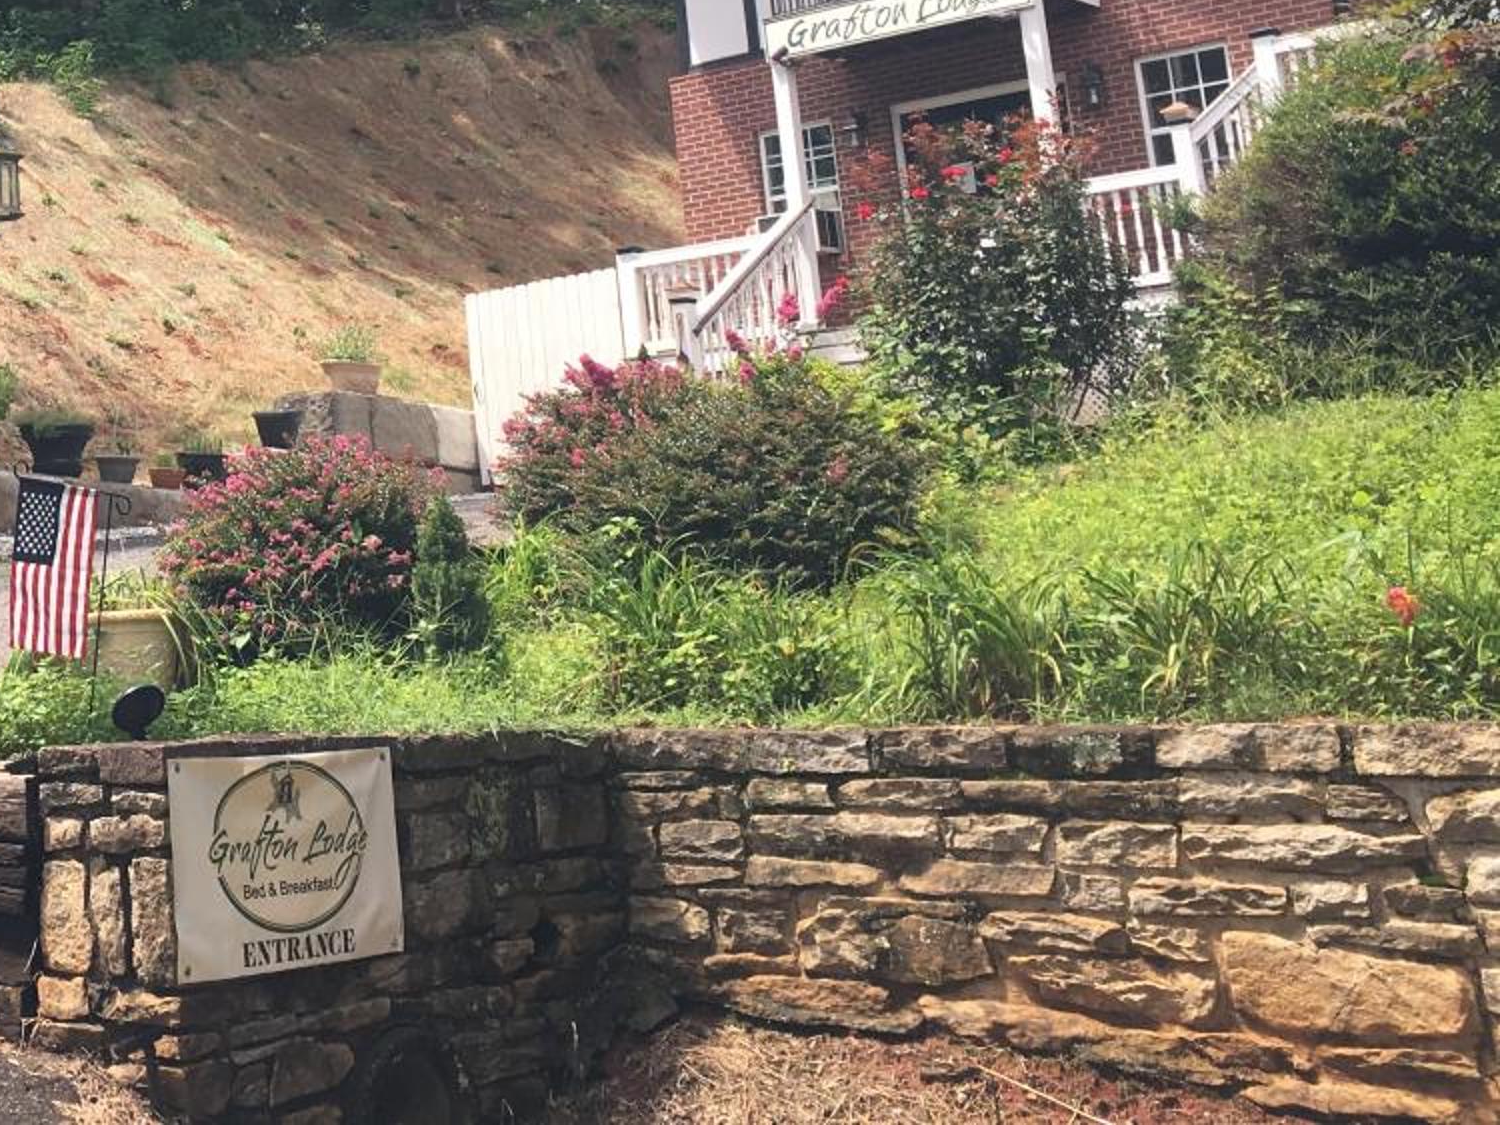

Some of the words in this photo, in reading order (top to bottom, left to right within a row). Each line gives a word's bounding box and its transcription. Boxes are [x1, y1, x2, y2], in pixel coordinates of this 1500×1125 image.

[787, 5, 908, 48] Grafton
[209, 815, 298, 880] Grafton
[303, 810, 368, 891] Lodge
[243, 882, 267, 900] Bed
[268, 882, 278, 898] &
[279, 876, 333, 896] Breakfast
[243, 928, 355, 968] ENTRANCE
